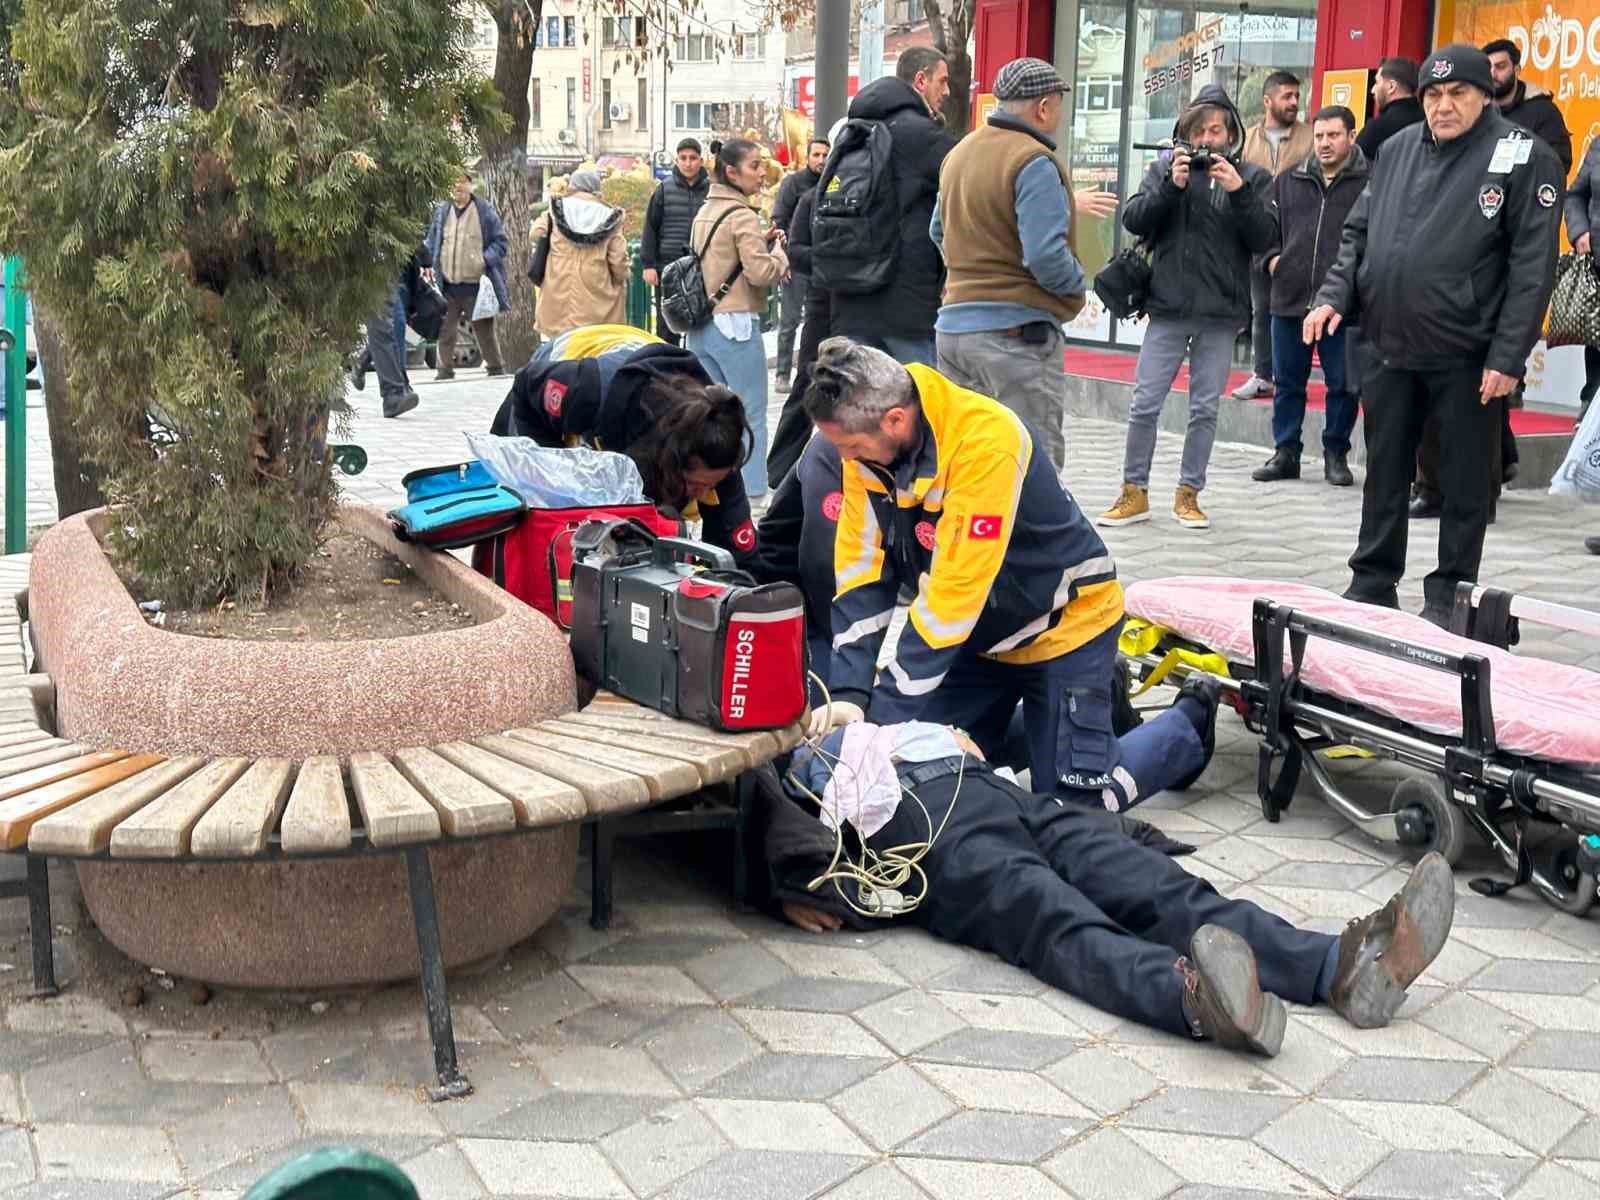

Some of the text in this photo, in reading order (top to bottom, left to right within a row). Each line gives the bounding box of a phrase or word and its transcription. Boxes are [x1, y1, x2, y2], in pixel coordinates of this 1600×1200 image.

[1193, 53, 1209, 73] 55
[1212, 45, 1225, 64] 77
[1558, 73, 1574, 100] En
[729, 629, 755, 719] SCHILLER
